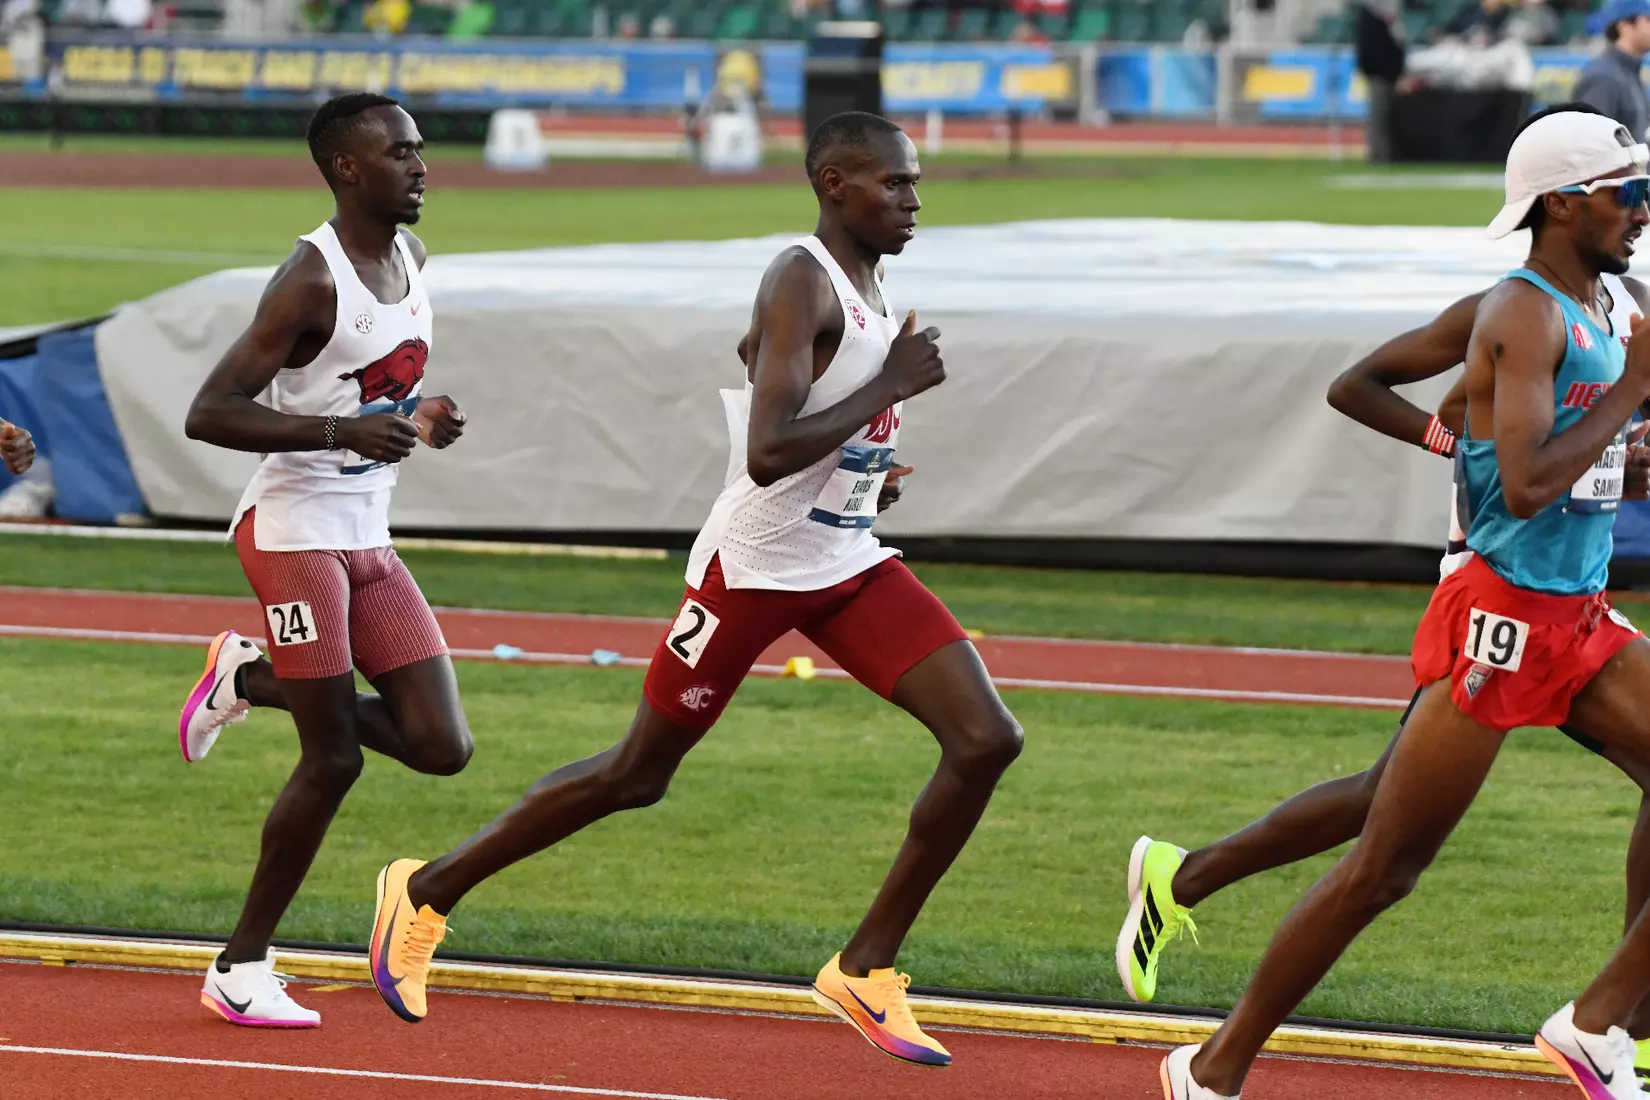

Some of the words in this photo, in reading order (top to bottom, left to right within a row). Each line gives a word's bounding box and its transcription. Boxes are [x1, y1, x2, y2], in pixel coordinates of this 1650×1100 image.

[271, 603, 309, 643] 24
[670, 605, 706, 660] 2
[1472, 613, 1518, 666] 19
